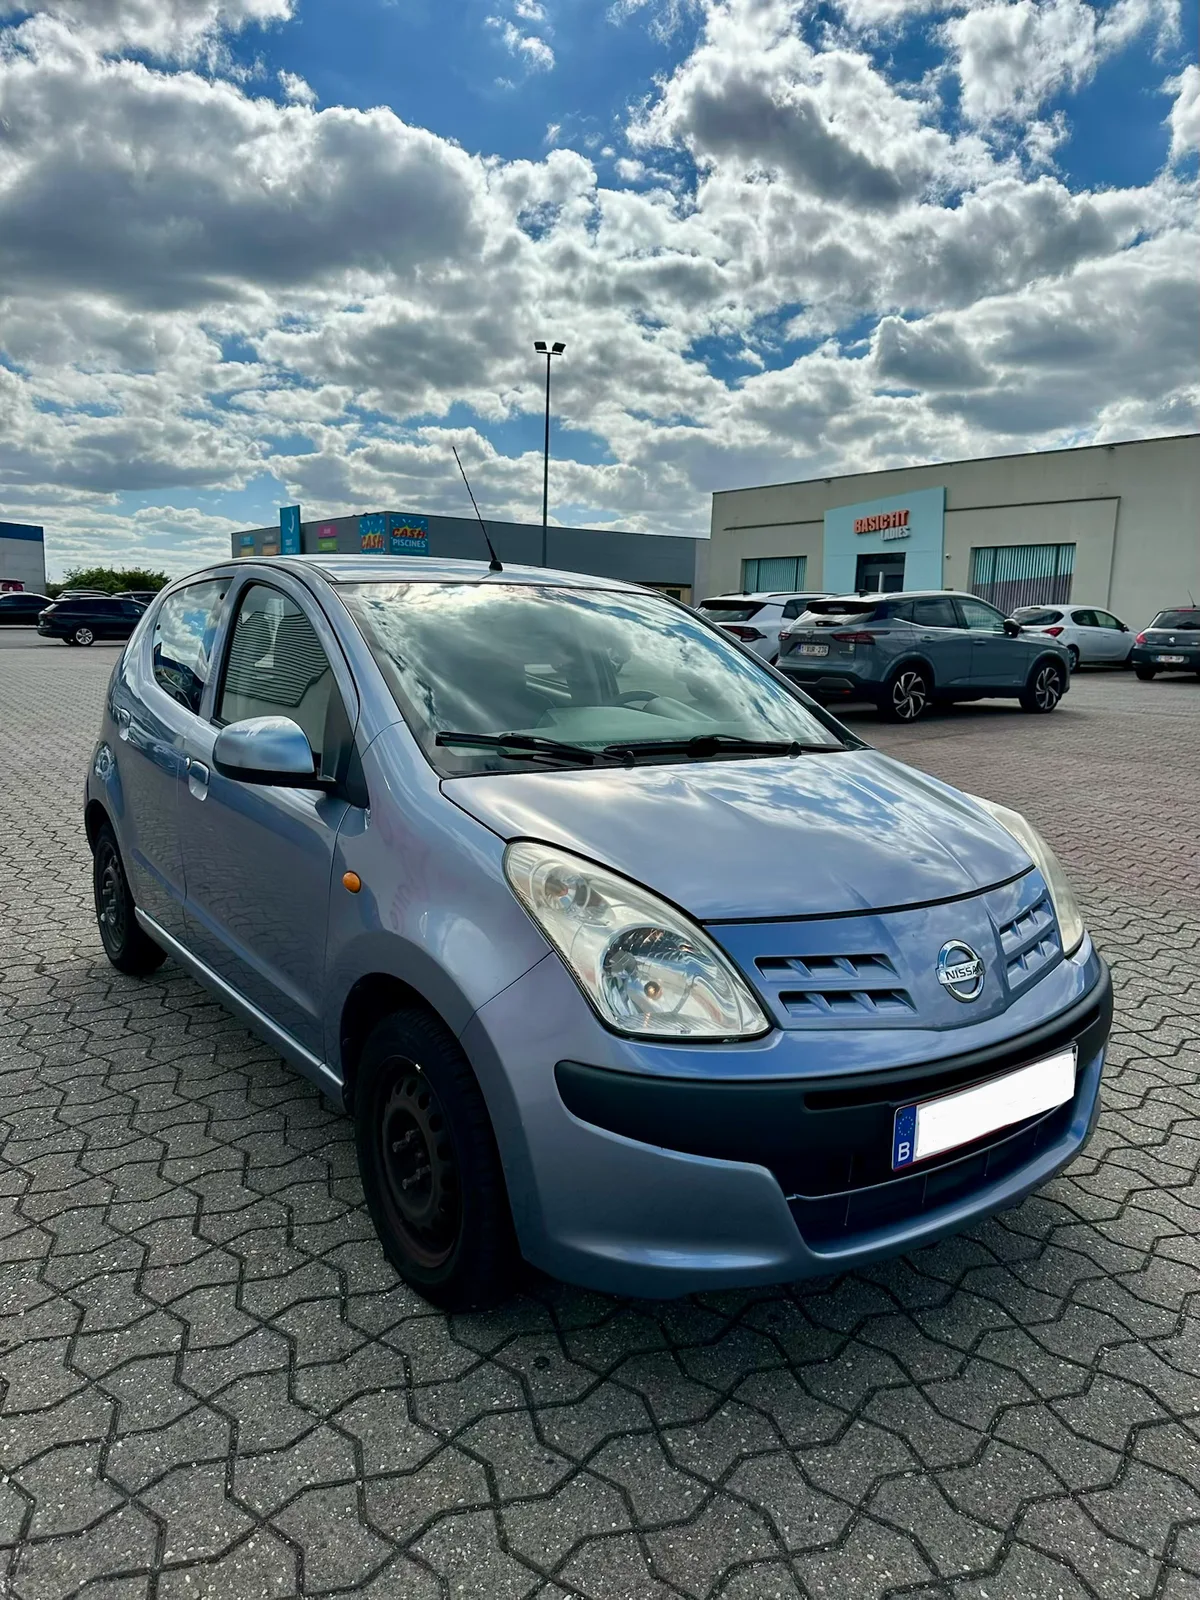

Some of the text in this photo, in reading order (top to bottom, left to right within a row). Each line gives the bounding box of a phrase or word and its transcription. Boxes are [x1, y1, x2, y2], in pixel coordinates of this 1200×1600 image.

[854, 510, 909, 534] BASIC-FIT
[392, 527, 426, 538] CASH
[880, 526, 910, 541] LADIES
[361, 534, 384, 549] CASH
[393, 538, 426, 548] PISCINES
[945, 964, 983, 981] NISSAN
[898, 1141, 911, 1162] B
